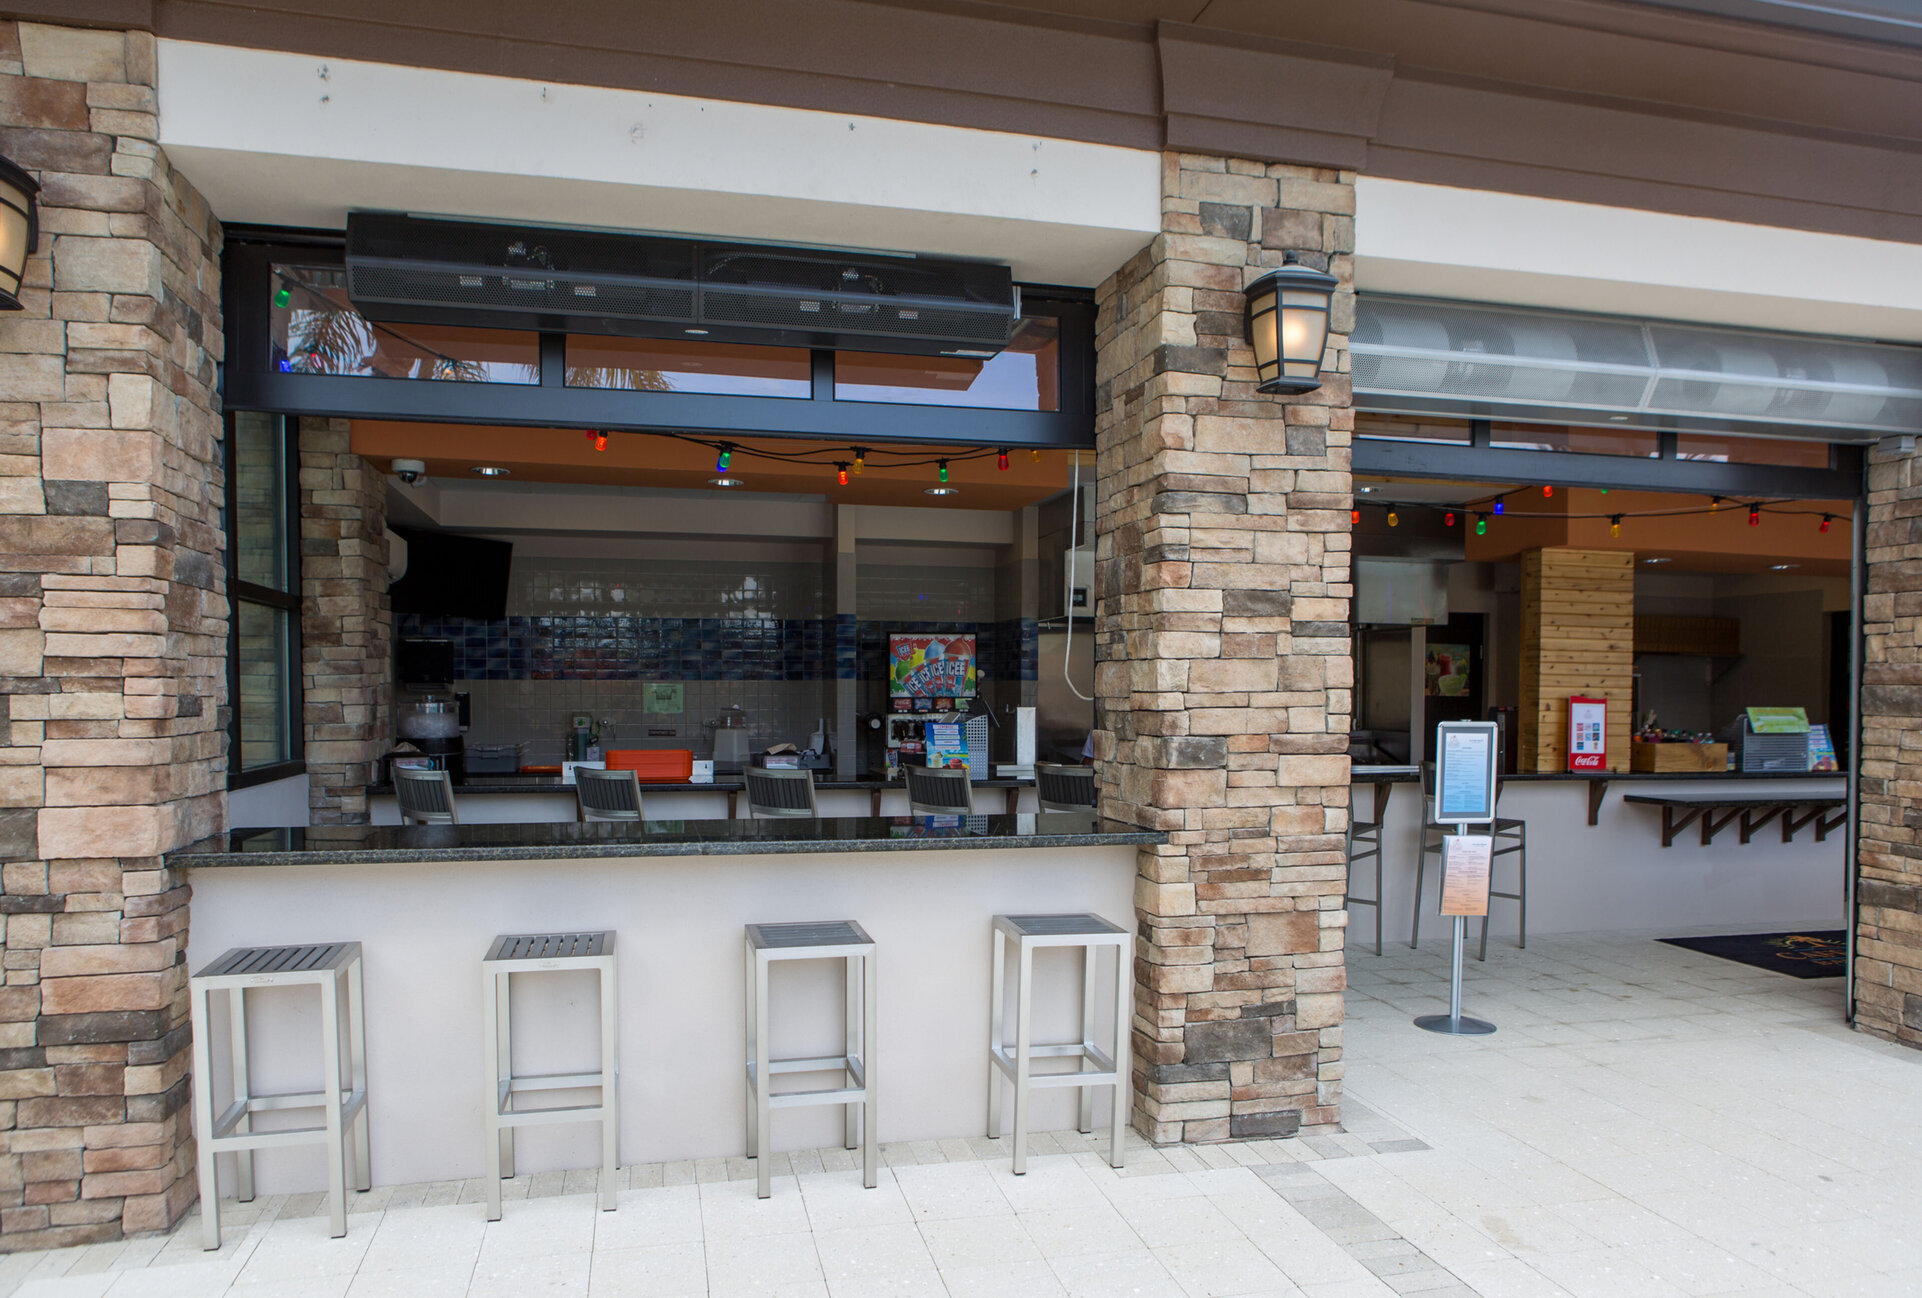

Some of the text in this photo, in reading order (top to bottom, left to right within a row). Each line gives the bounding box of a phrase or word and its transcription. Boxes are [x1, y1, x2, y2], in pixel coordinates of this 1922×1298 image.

[930, 662, 944, 677] ICE
[946, 662, 965, 675] ICEE
[906, 676, 921, 693] ICE
